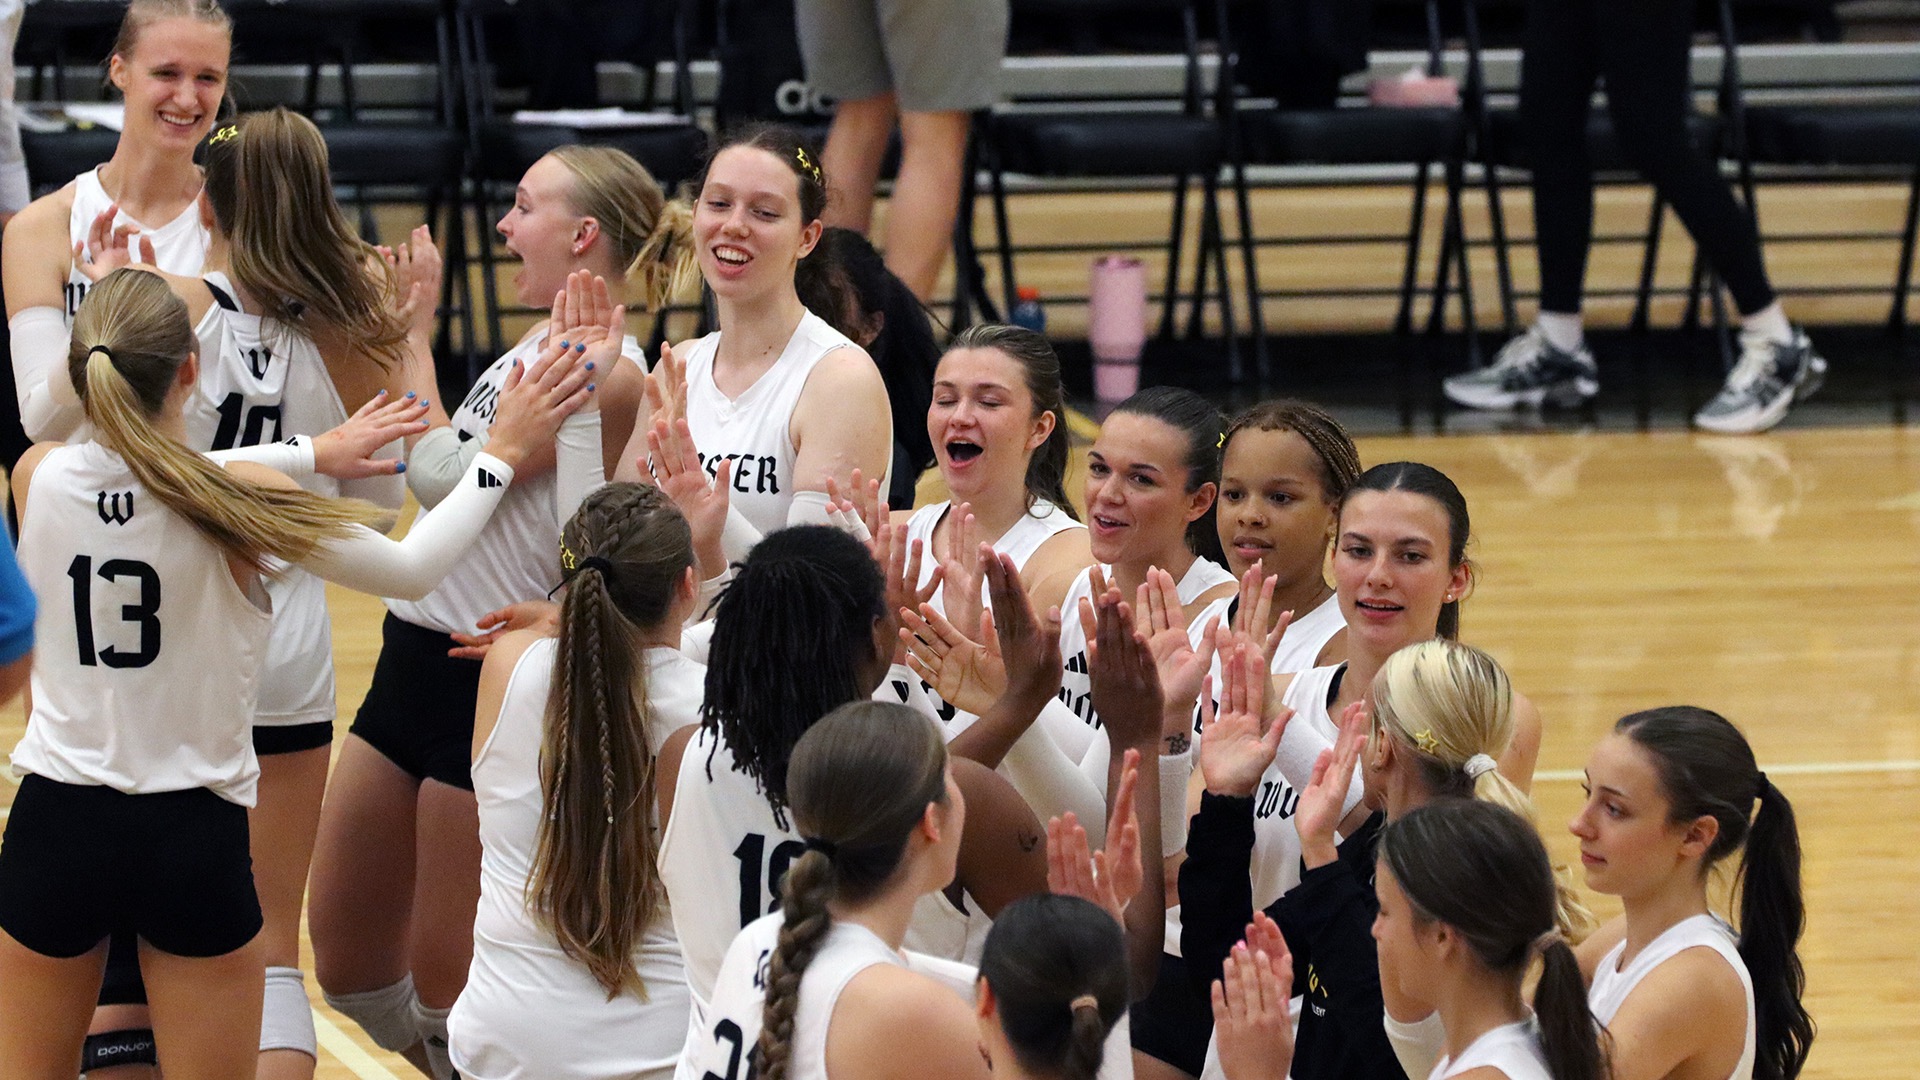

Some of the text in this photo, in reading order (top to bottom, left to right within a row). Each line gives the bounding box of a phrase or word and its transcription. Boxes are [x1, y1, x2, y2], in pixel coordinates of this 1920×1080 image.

[67, 554, 161, 669] 13
[97, 1042, 151, 1057] DONJOY
[701, 1018, 763, 1080] 2
